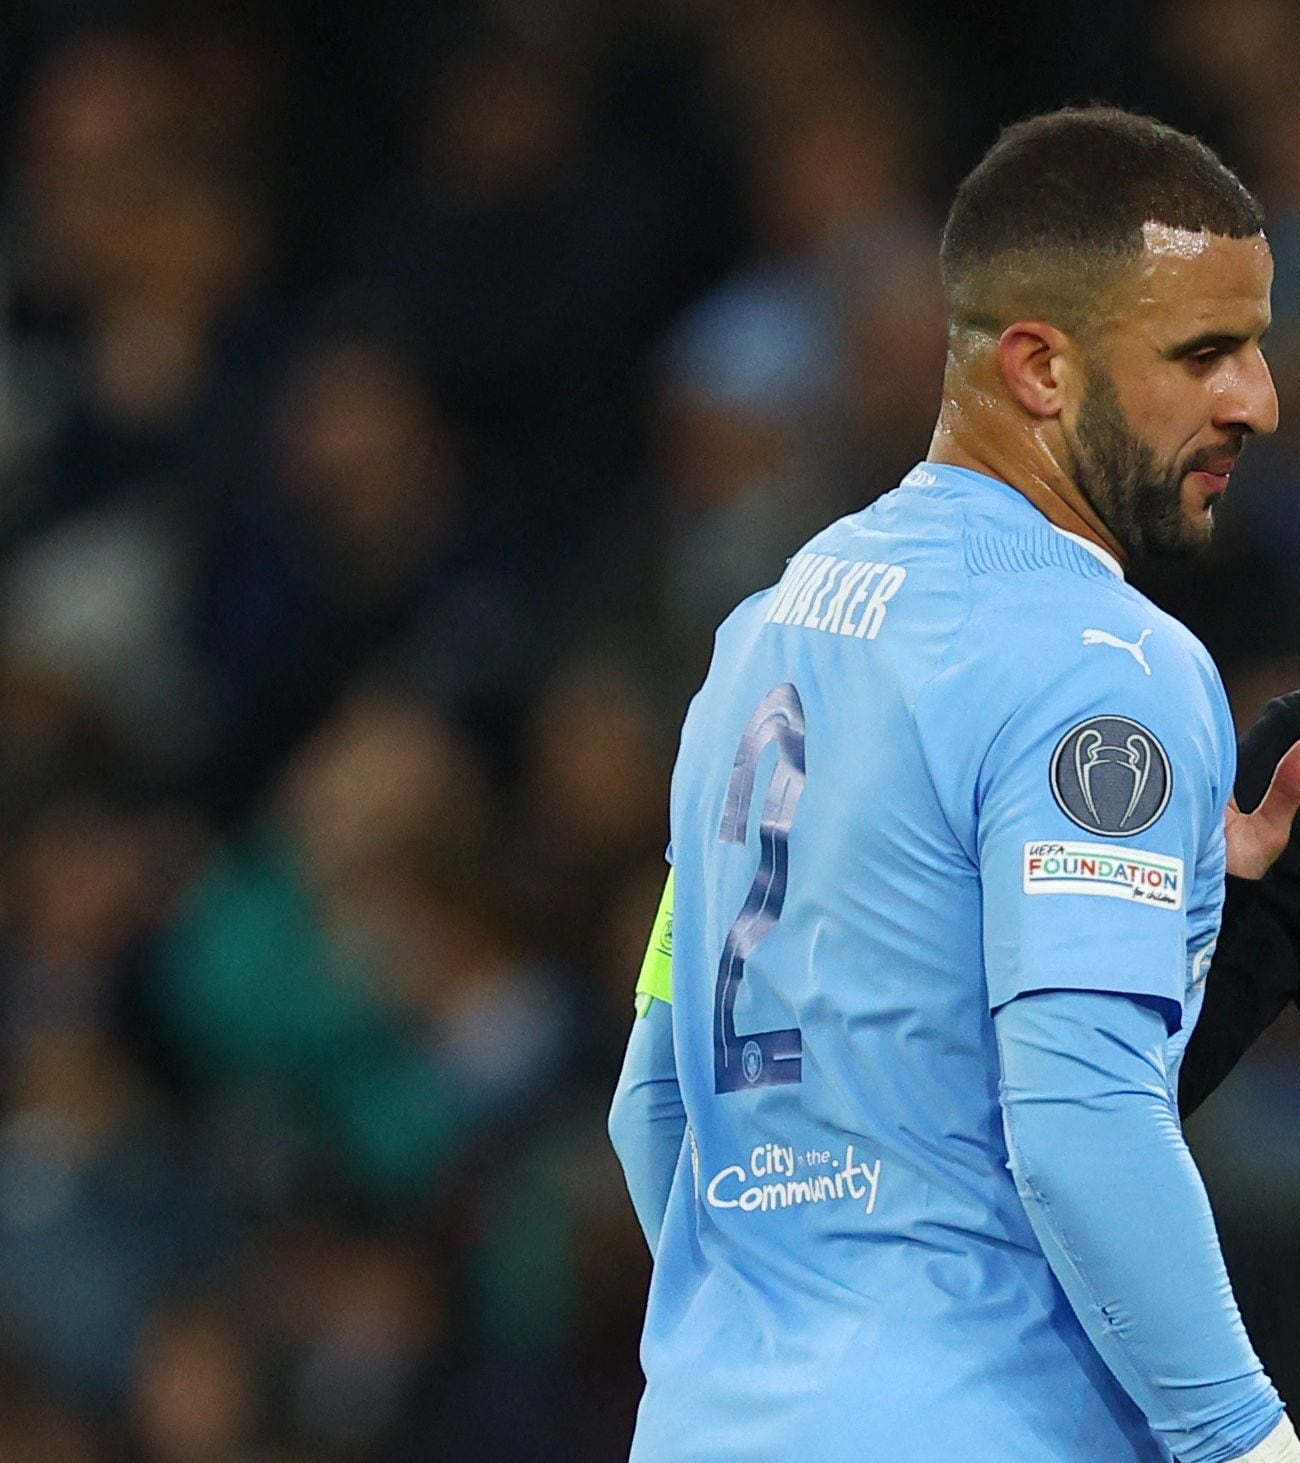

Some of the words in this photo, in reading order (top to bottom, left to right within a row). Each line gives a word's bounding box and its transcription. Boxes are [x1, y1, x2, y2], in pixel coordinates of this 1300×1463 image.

[764, 552, 907, 640] WALKER
[1028, 844, 1065, 856] UEFA
[714, 682, 806, 1095] 2
[1029, 858, 1178, 891] FOUNDATION
[1132, 886, 1145, 899] for
[751, 1143, 794, 1177] City
[806, 1149, 831, 1167] the
[707, 1145, 881, 1215] Community
